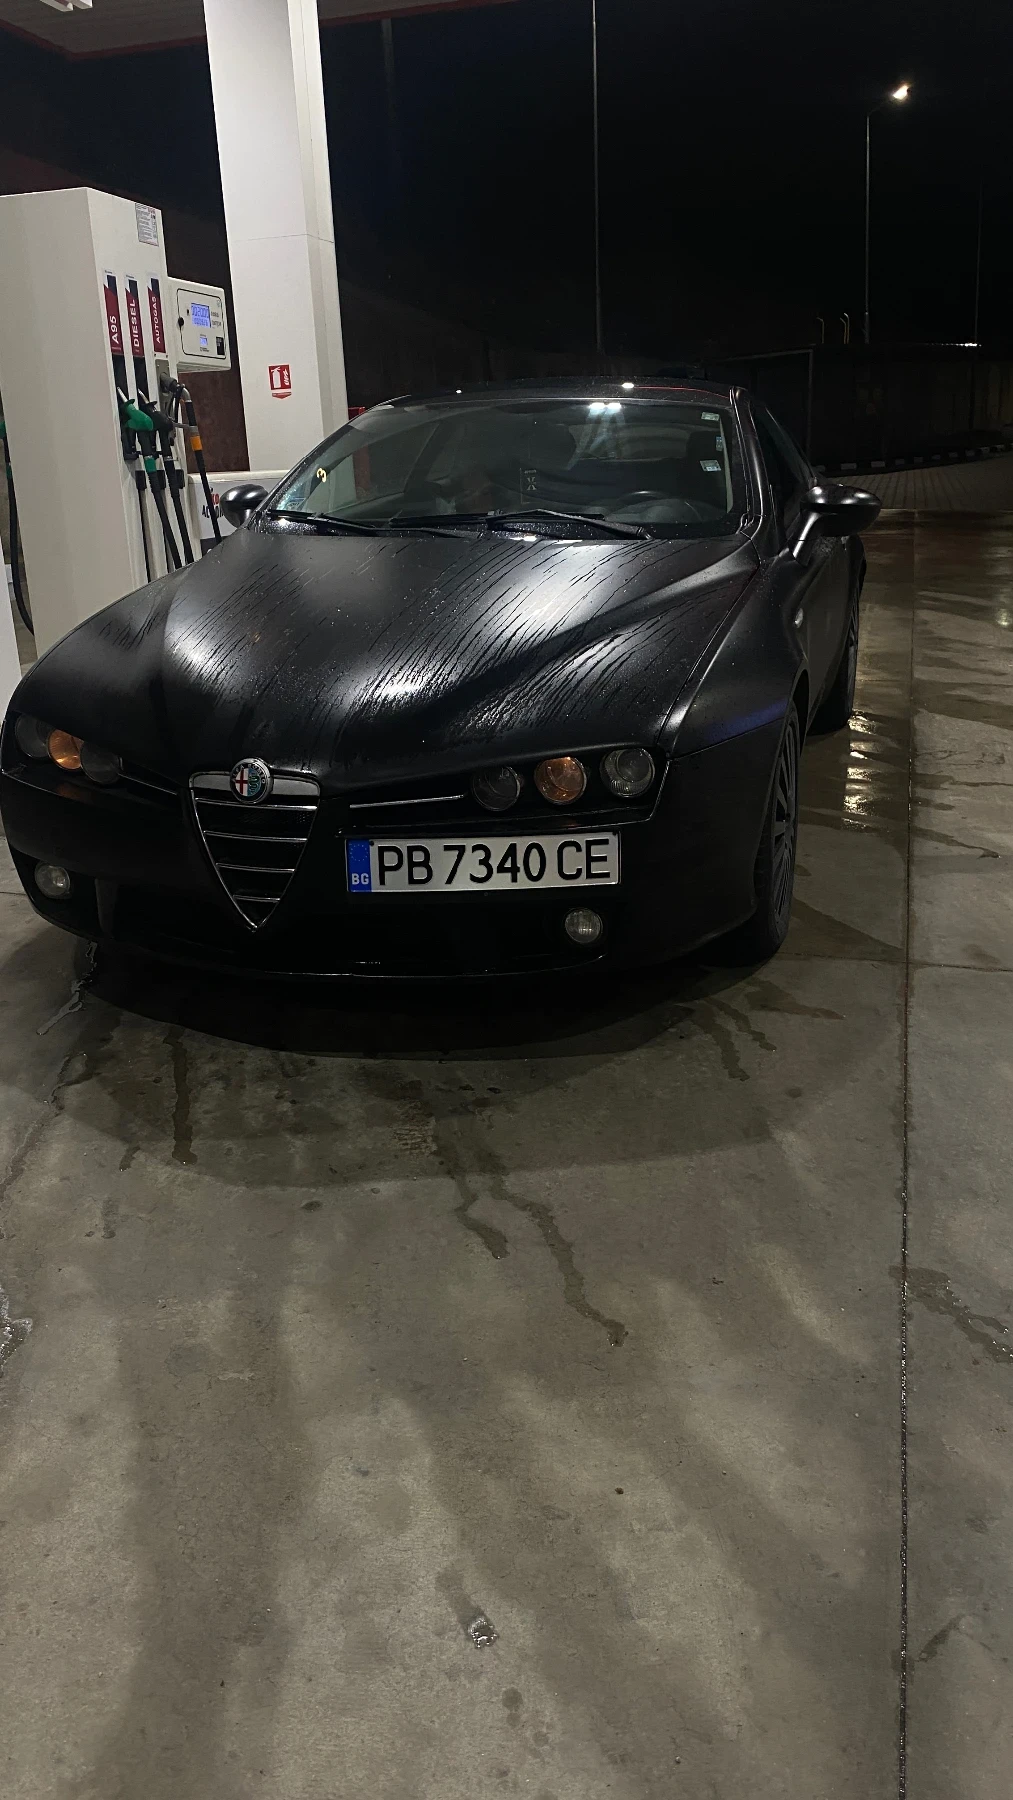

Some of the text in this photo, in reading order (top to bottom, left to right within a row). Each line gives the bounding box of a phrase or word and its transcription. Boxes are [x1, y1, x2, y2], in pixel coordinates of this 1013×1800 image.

[109, 315, 120, 345] A95
[129, 299, 140, 347] DIESEL
[151, 296, 161, 344] AUTOGAS
[351, 873, 370, 885] BG
[377, 838, 611, 886] PB 7340 CE
